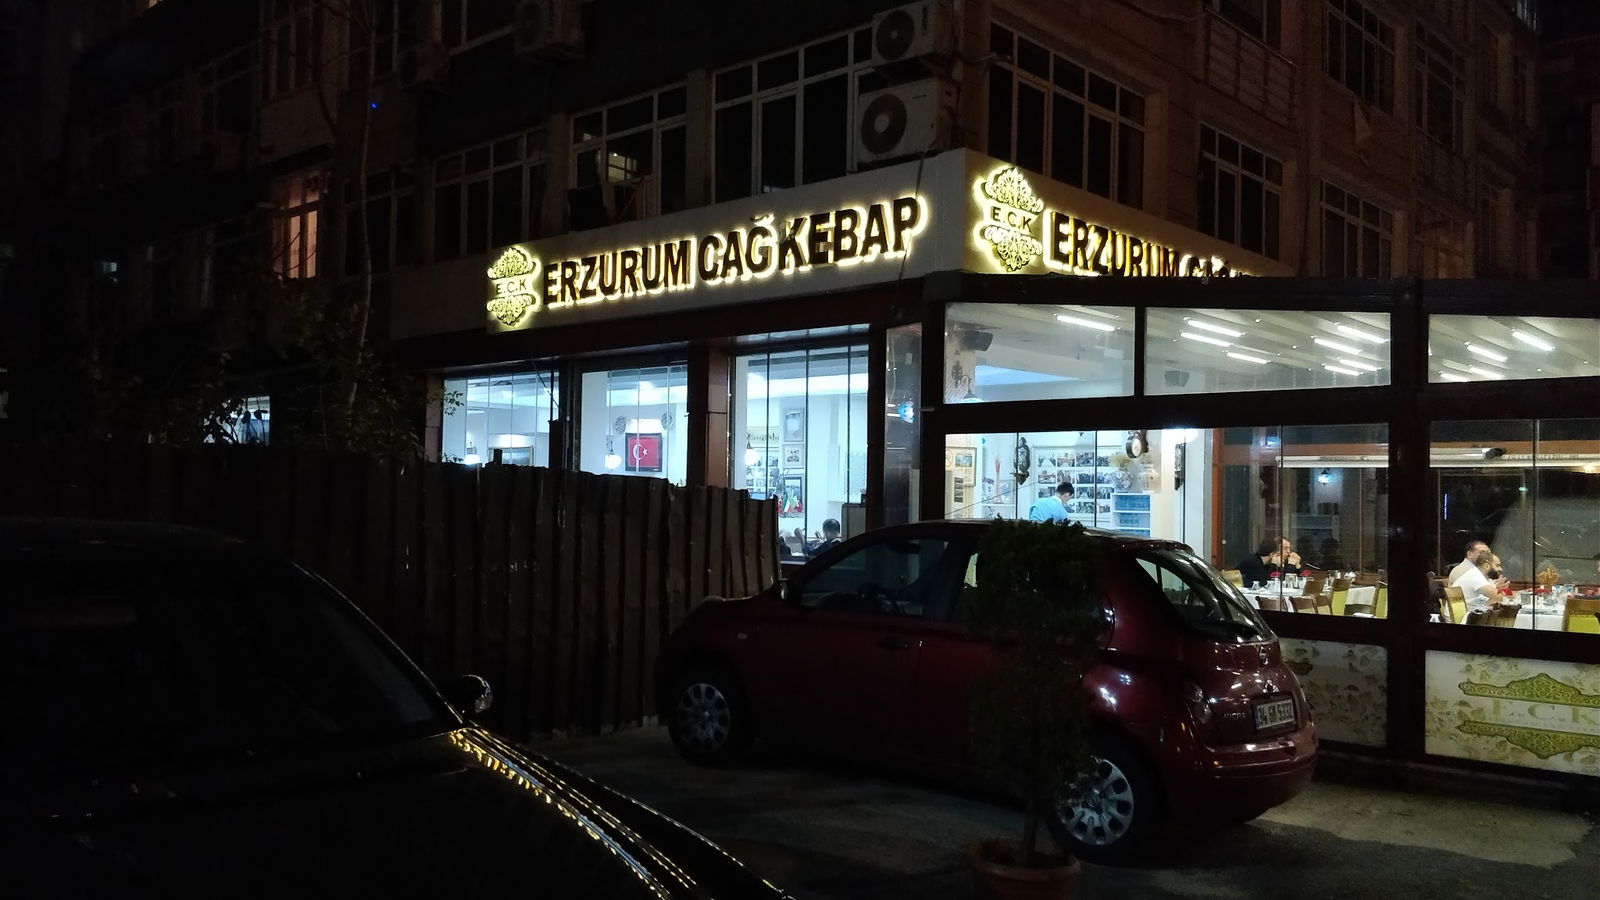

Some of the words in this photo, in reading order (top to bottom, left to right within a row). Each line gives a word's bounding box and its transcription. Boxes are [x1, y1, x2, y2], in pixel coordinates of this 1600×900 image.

[992, 206, 1033, 233] E.C.K
[543, 240, 692, 305] ERZURUM
[778, 196, 922, 270] KEBAP
[495, 278, 527, 295] E.C.K
